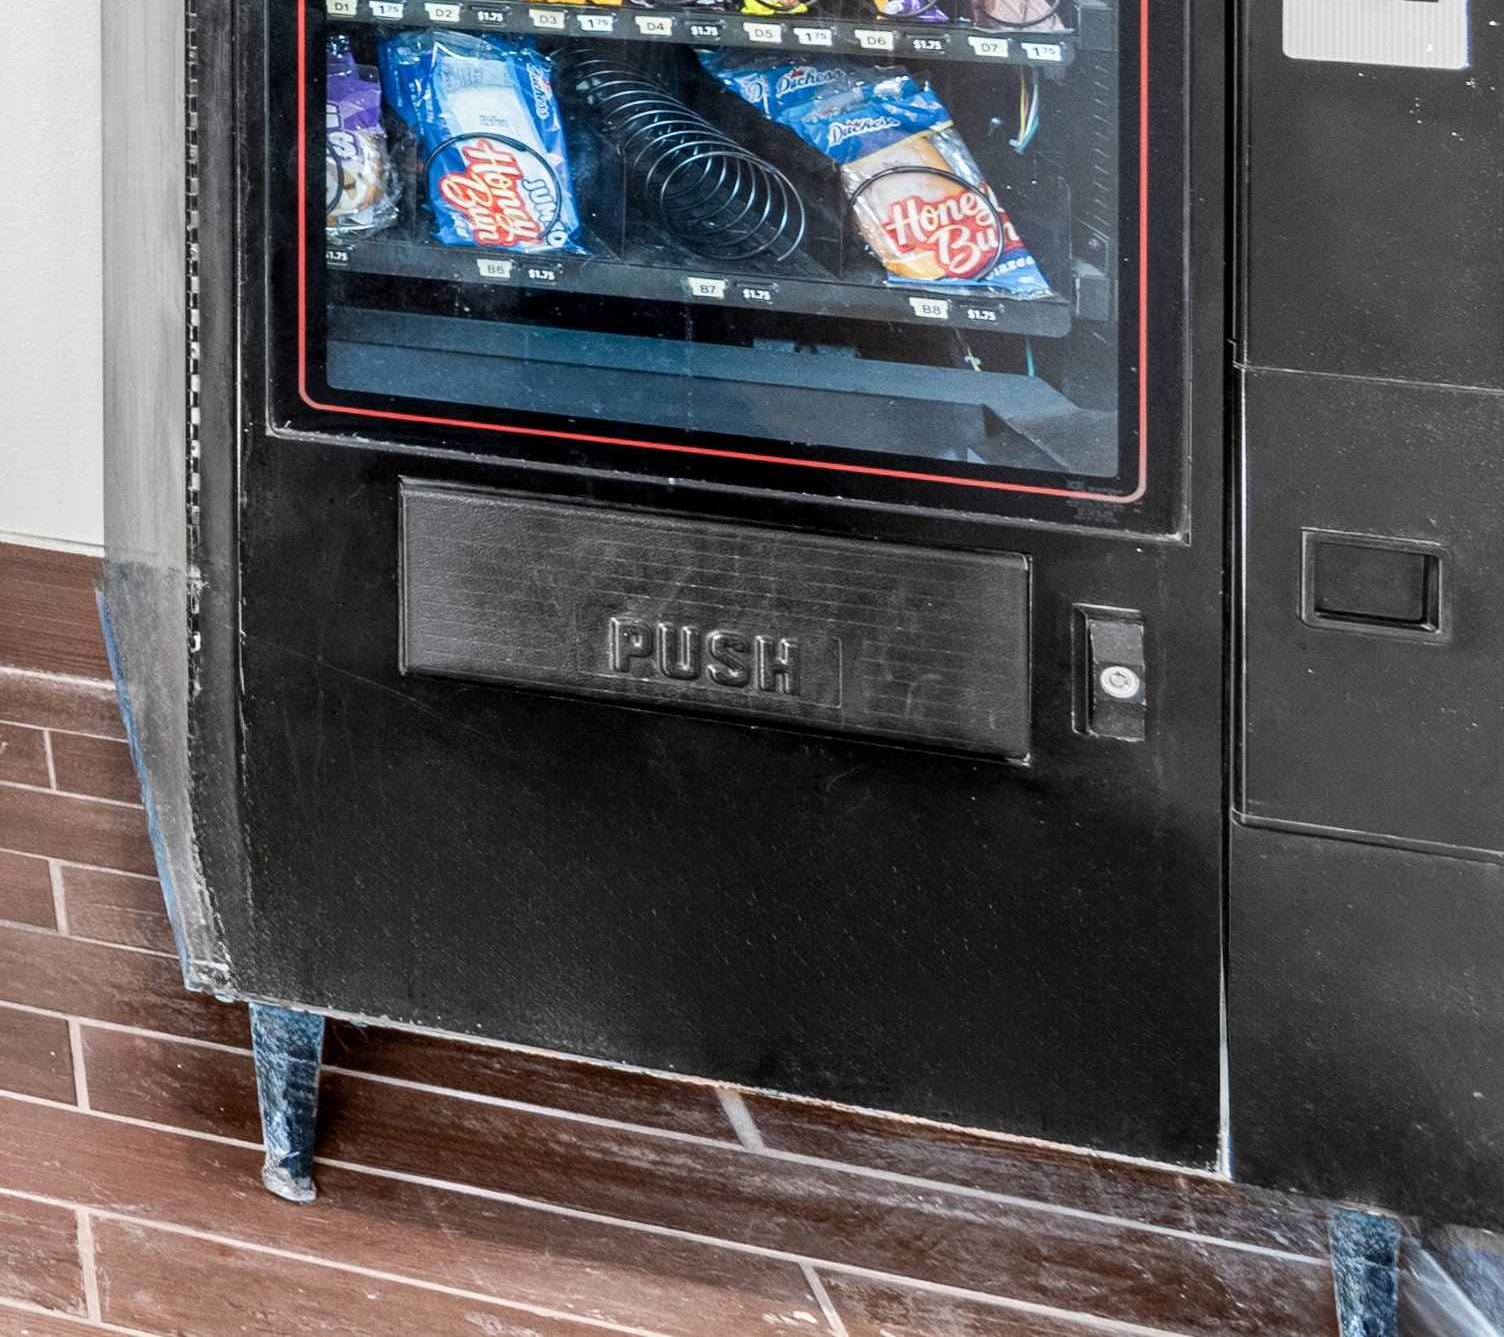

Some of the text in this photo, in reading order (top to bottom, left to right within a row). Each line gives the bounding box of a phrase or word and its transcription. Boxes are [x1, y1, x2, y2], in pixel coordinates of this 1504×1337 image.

[334, 3, 349, 12] D1
[435, 8, 452, 18] D2
[539, 15, 557, 24] D3
[647, 22, 718, 36] D4 $1.75
[755, 29, 773, 38] D5
[867, 36, 942, 50] D6 $1.75
[981, 42, 998, 53] D7
[826, 116, 901, 146] Duchess
[462, 138, 532, 245] Honey
[439, 174, 499, 241] Bun
[488, 264, 505, 274] B6
[700, 284, 717, 294] B7
[922, 304, 941, 315] B8
[606, 611, 804, 699] PUSH
